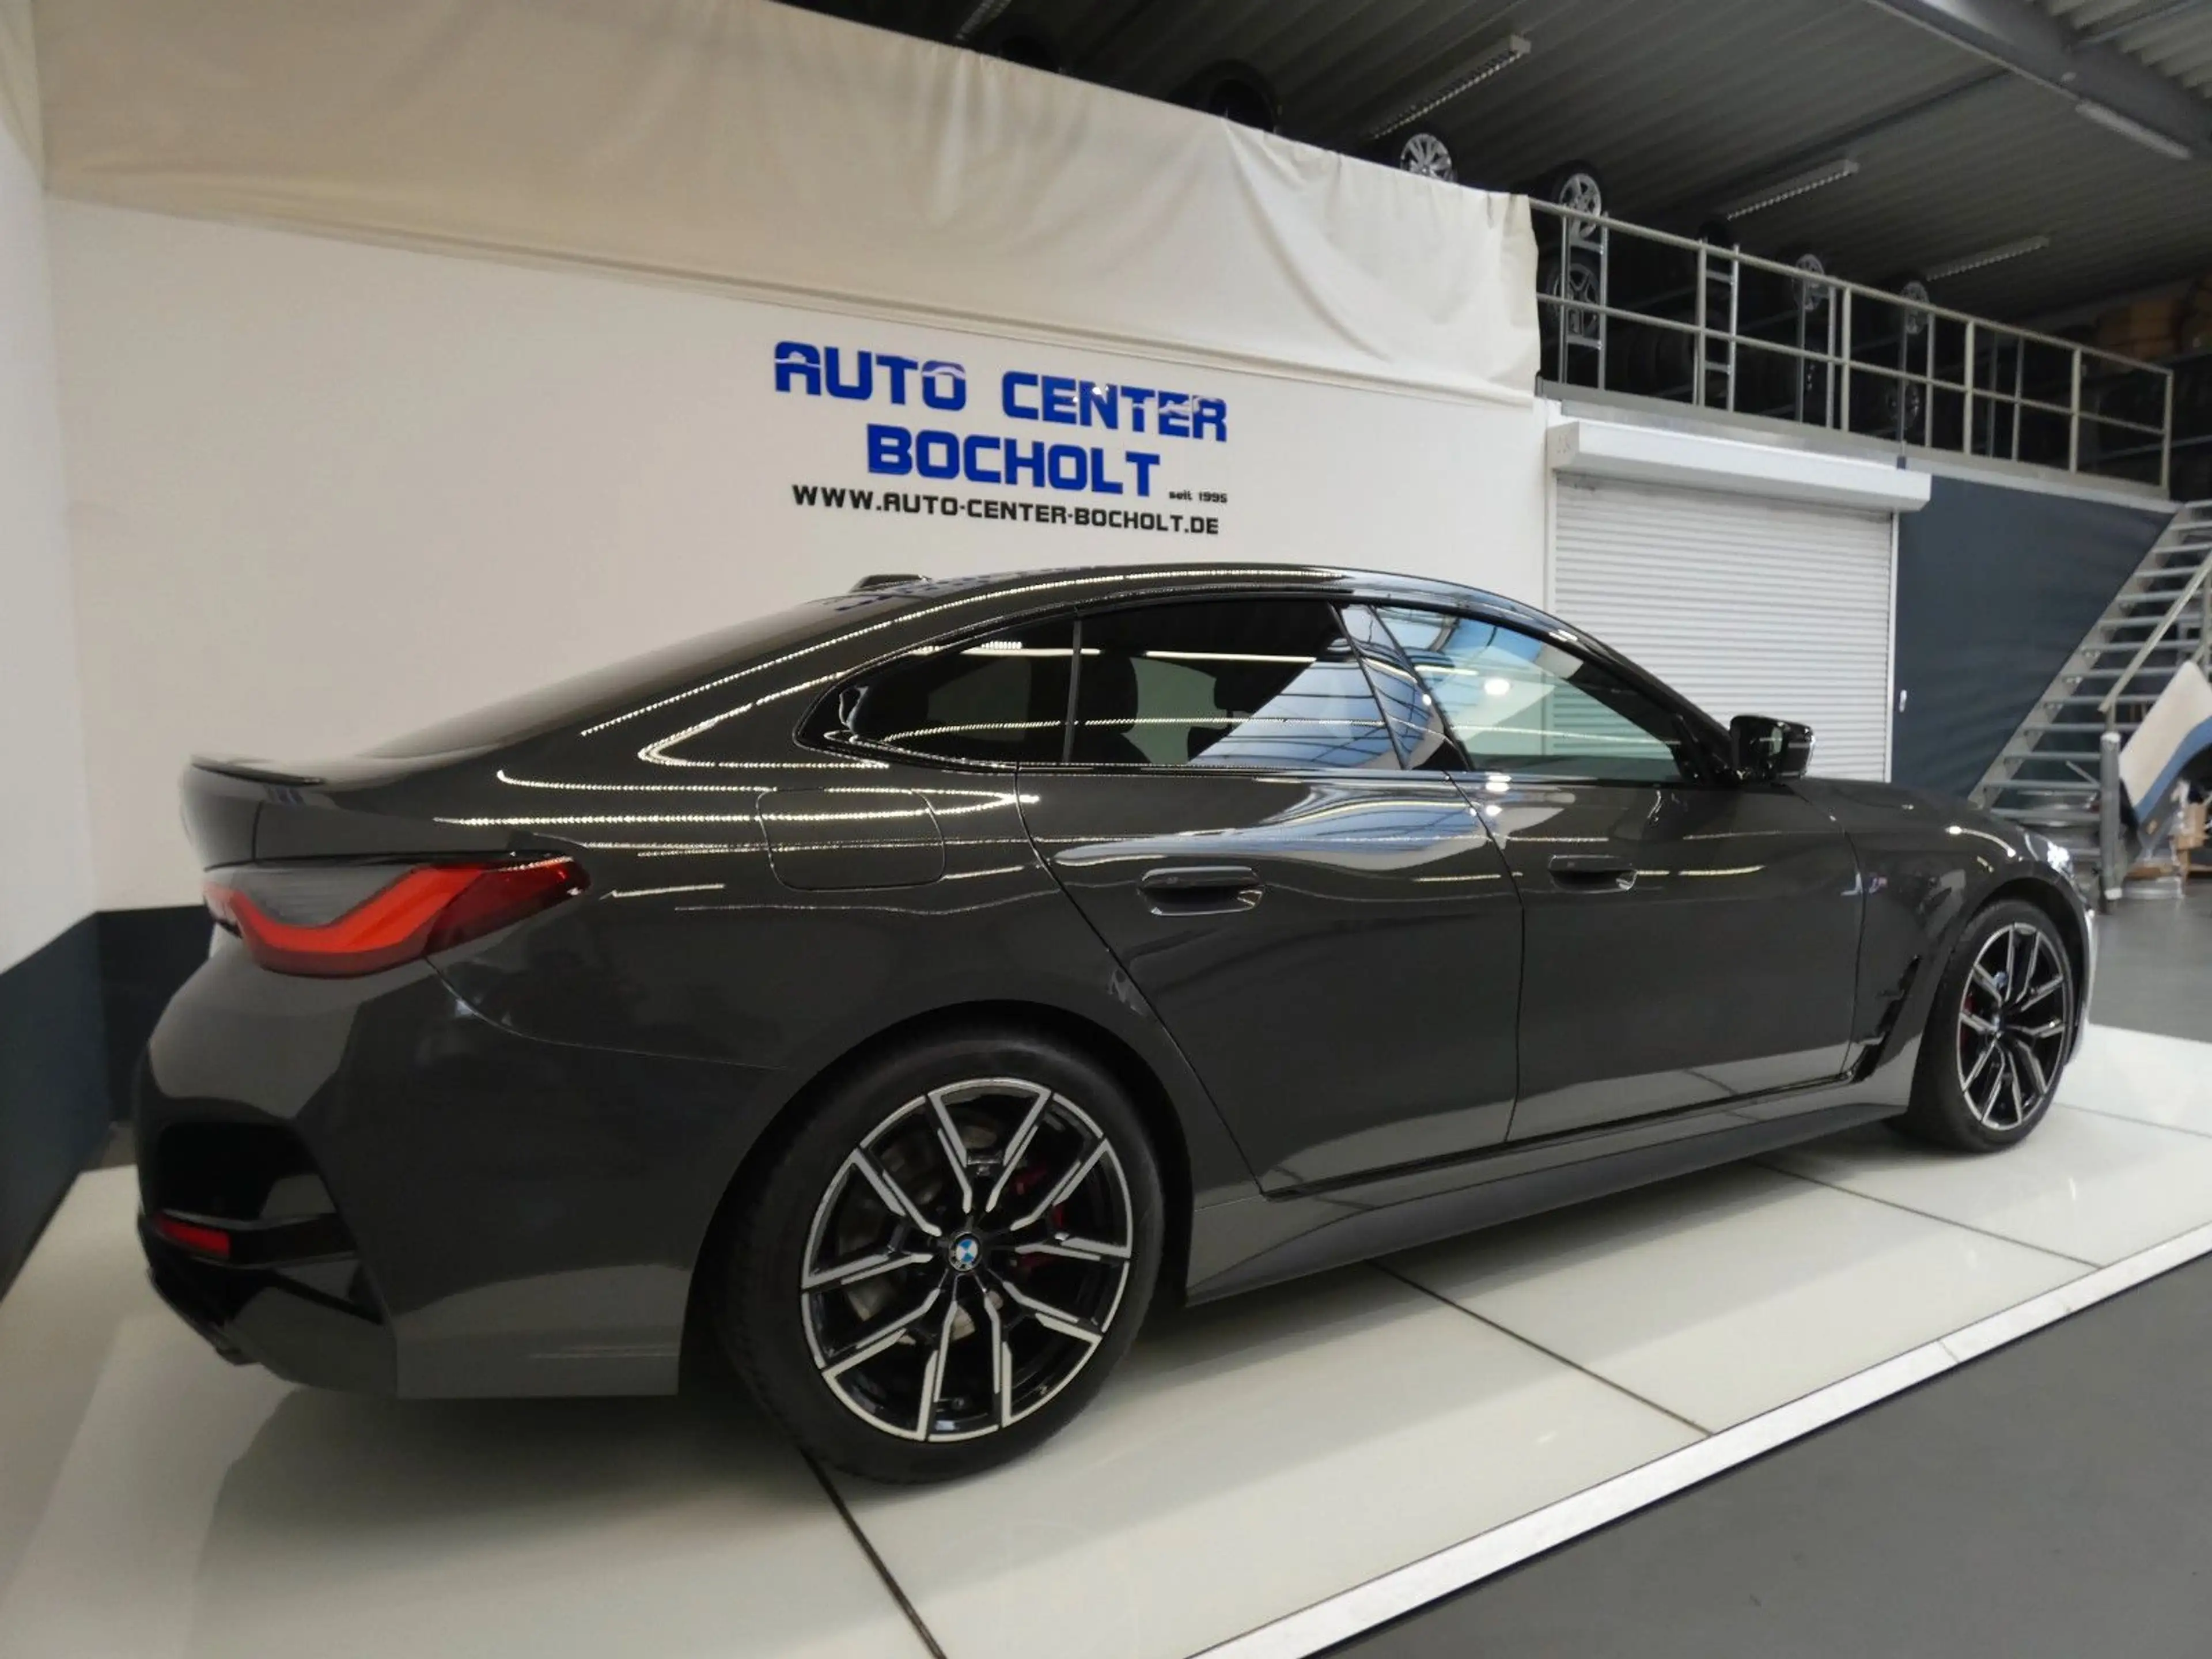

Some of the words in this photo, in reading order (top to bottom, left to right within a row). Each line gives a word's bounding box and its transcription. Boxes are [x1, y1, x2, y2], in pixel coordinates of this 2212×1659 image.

[774, 341, 967, 411] AUTO
[1002, 370, 1228, 442] CENTER
[866, 423, 1160, 497] BOCHOLT
[792, 484, 1219, 535] WWW.AUTO-CENTER-BOCHOLT.DE
[1199, 491, 1228, 503] 1995
